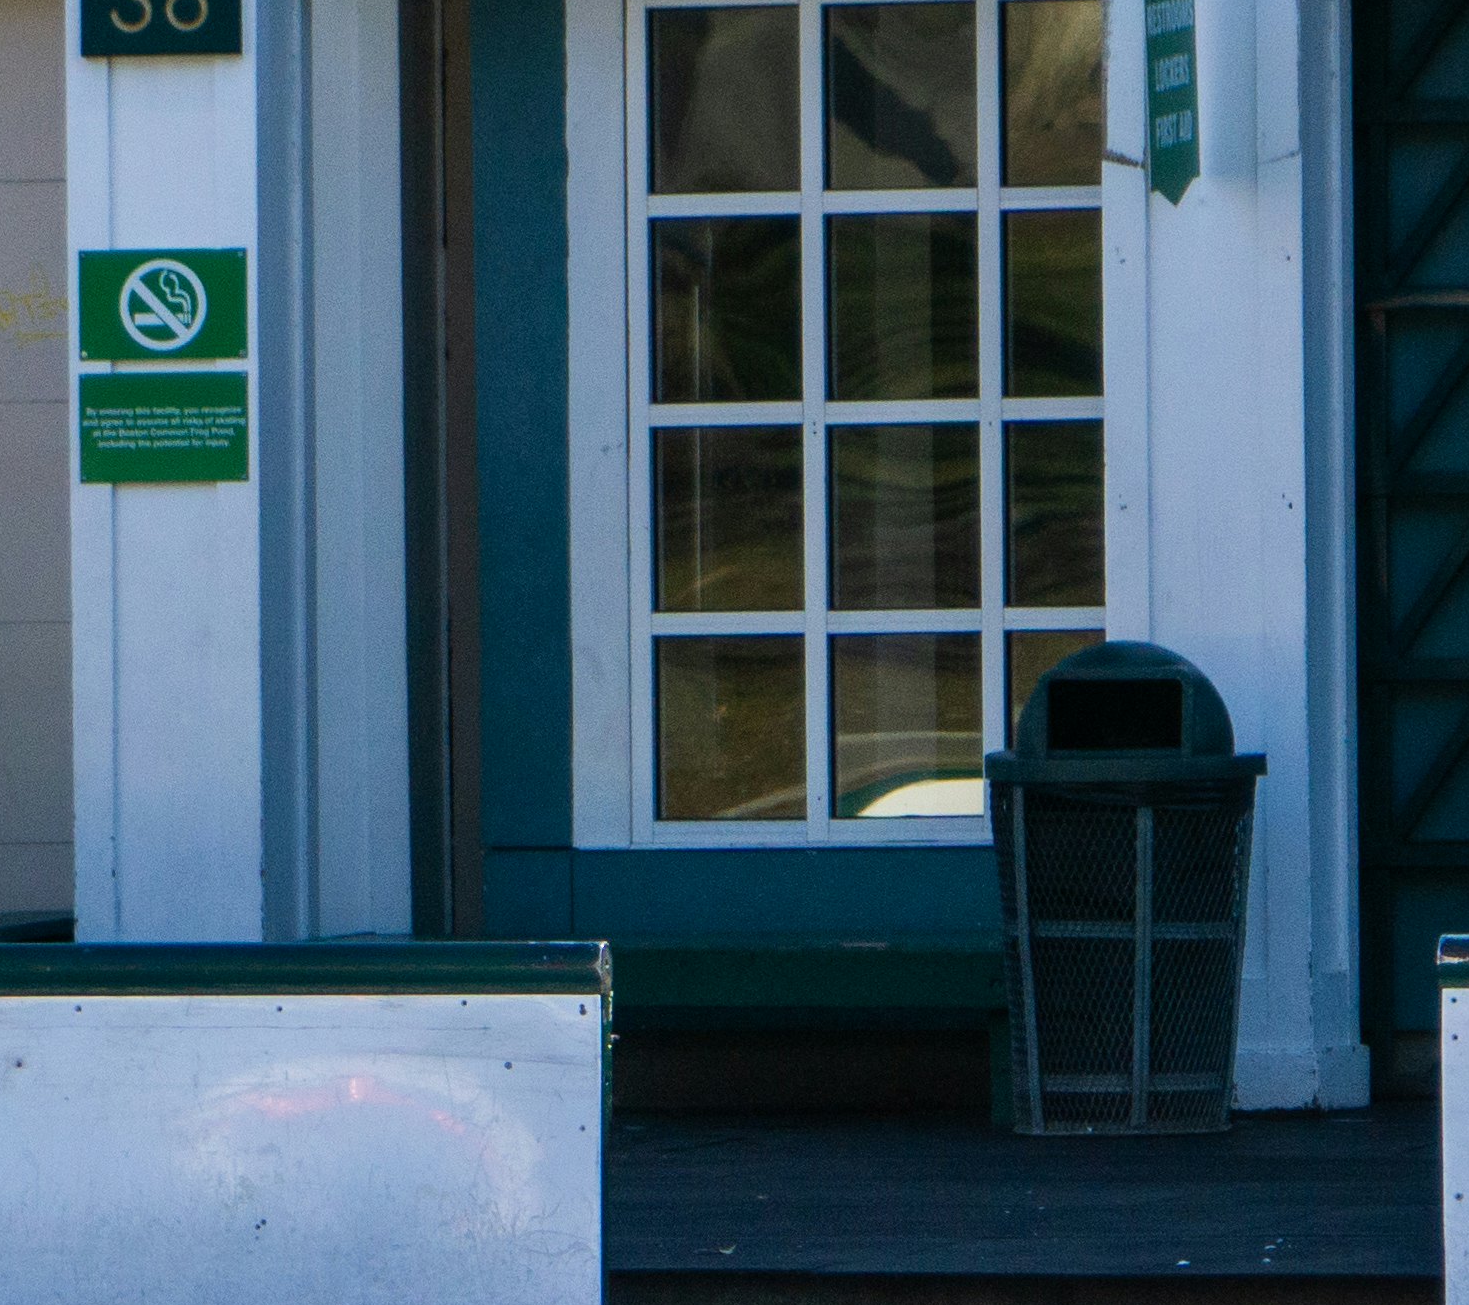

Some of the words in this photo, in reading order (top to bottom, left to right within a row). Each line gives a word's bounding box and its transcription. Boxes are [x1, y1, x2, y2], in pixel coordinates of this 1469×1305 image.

[1155, 53, 1191, 93] LOCKERS
[1155, 114, 1177, 150] FIRST
[1178, 109, 1193, 143] AID
